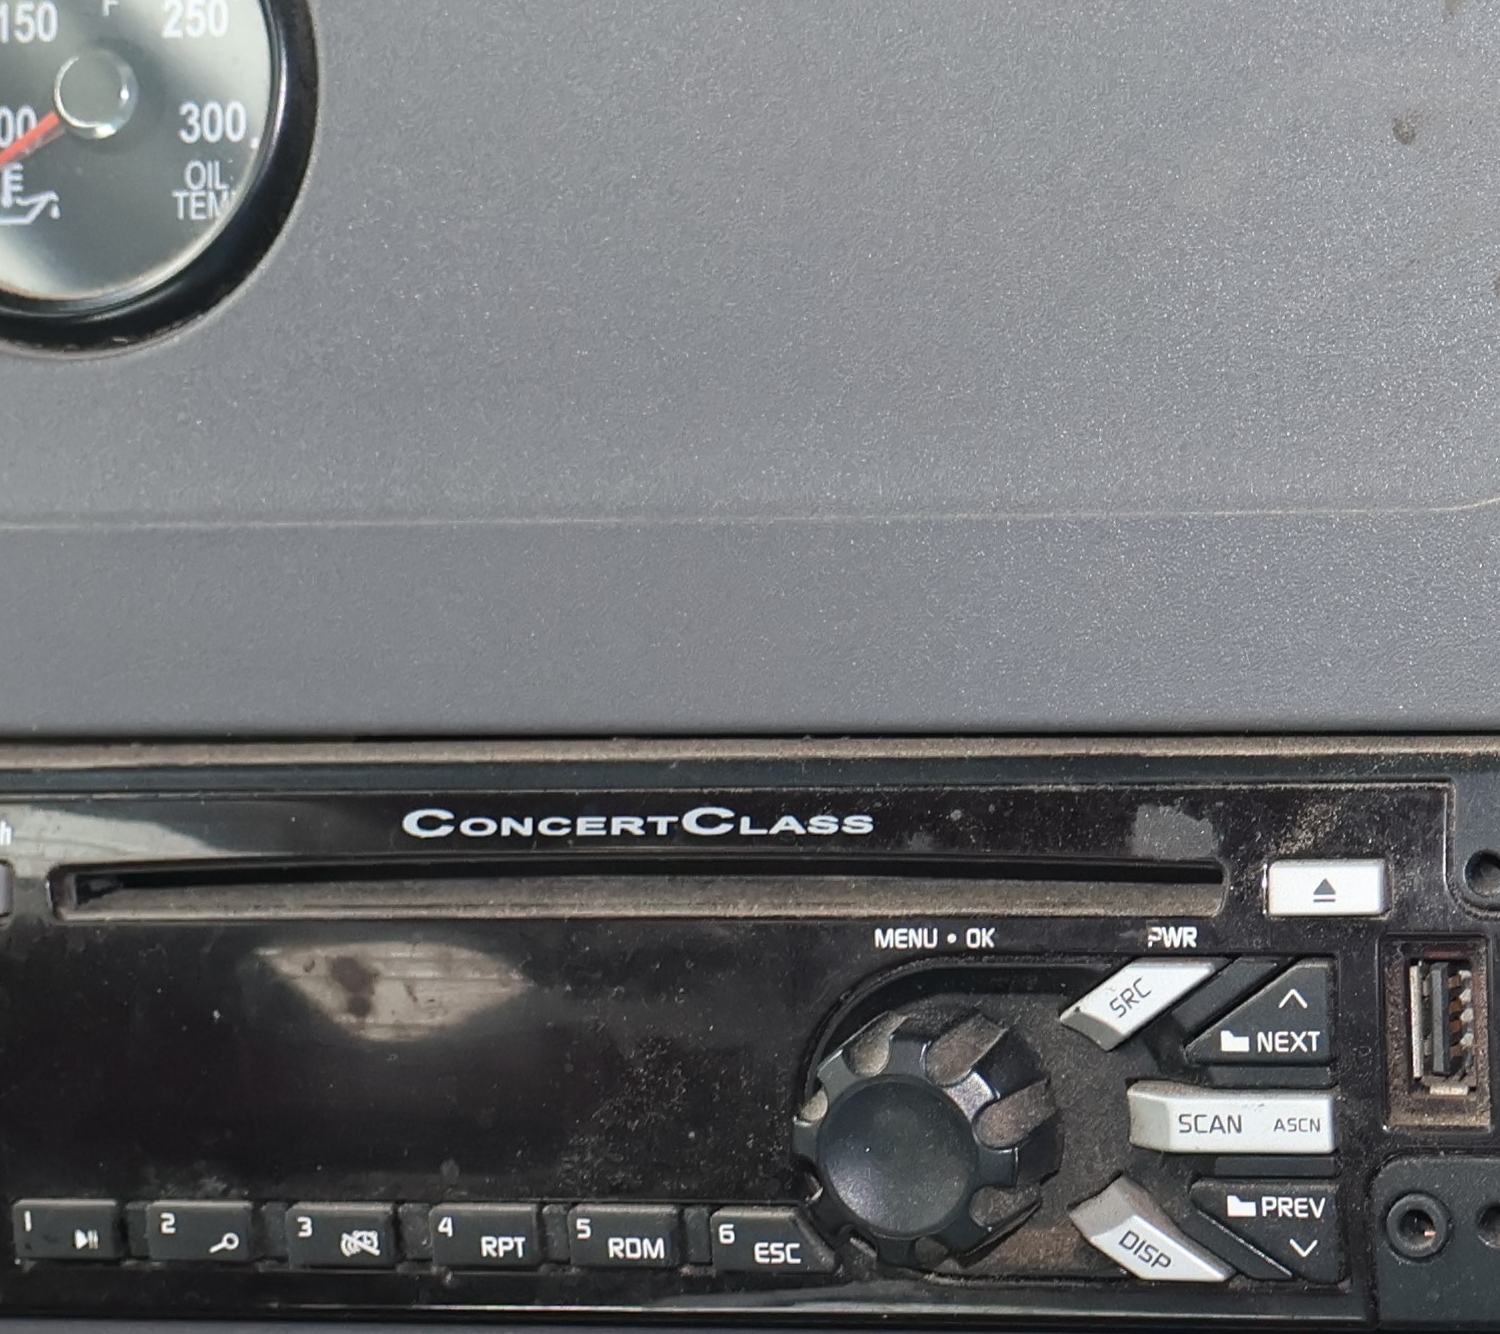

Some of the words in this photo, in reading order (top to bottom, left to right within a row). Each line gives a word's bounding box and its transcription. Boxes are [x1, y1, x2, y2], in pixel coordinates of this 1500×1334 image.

[179, 100, 246, 143] 300
[184, 159, 230, 190] OIL
[874, 927, 938, 948] MENU
[965, 927, 995, 948] OK
[1147, 927, 1197, 948] PWR
[1108, 978, 1152, 1019] SRC
[1256, 1030, 1321, 1054] NEXT
[1177, 1112, 1243, 1135] SCAN
[1273, 1116, 1321, 1134] ASCN
[1261, 1195, 1326, 1219] PREV
[24, 1211, 33, 1232] 1
[160, 1212, 175, 1234] 2
[298, 1216, 313, 1237] 3
[437, 1217, 453, 1237] 4
[481, 1236, 525, 1258] RPT
[576, 1218, 592, 1239] 5
[608, 1237, 665, 1260] RDM
[718, 1223, 735, 1244] 6
[753, 1242, 801, 1265] ESC
[1118, 1228, 1172, 1272] DISP
